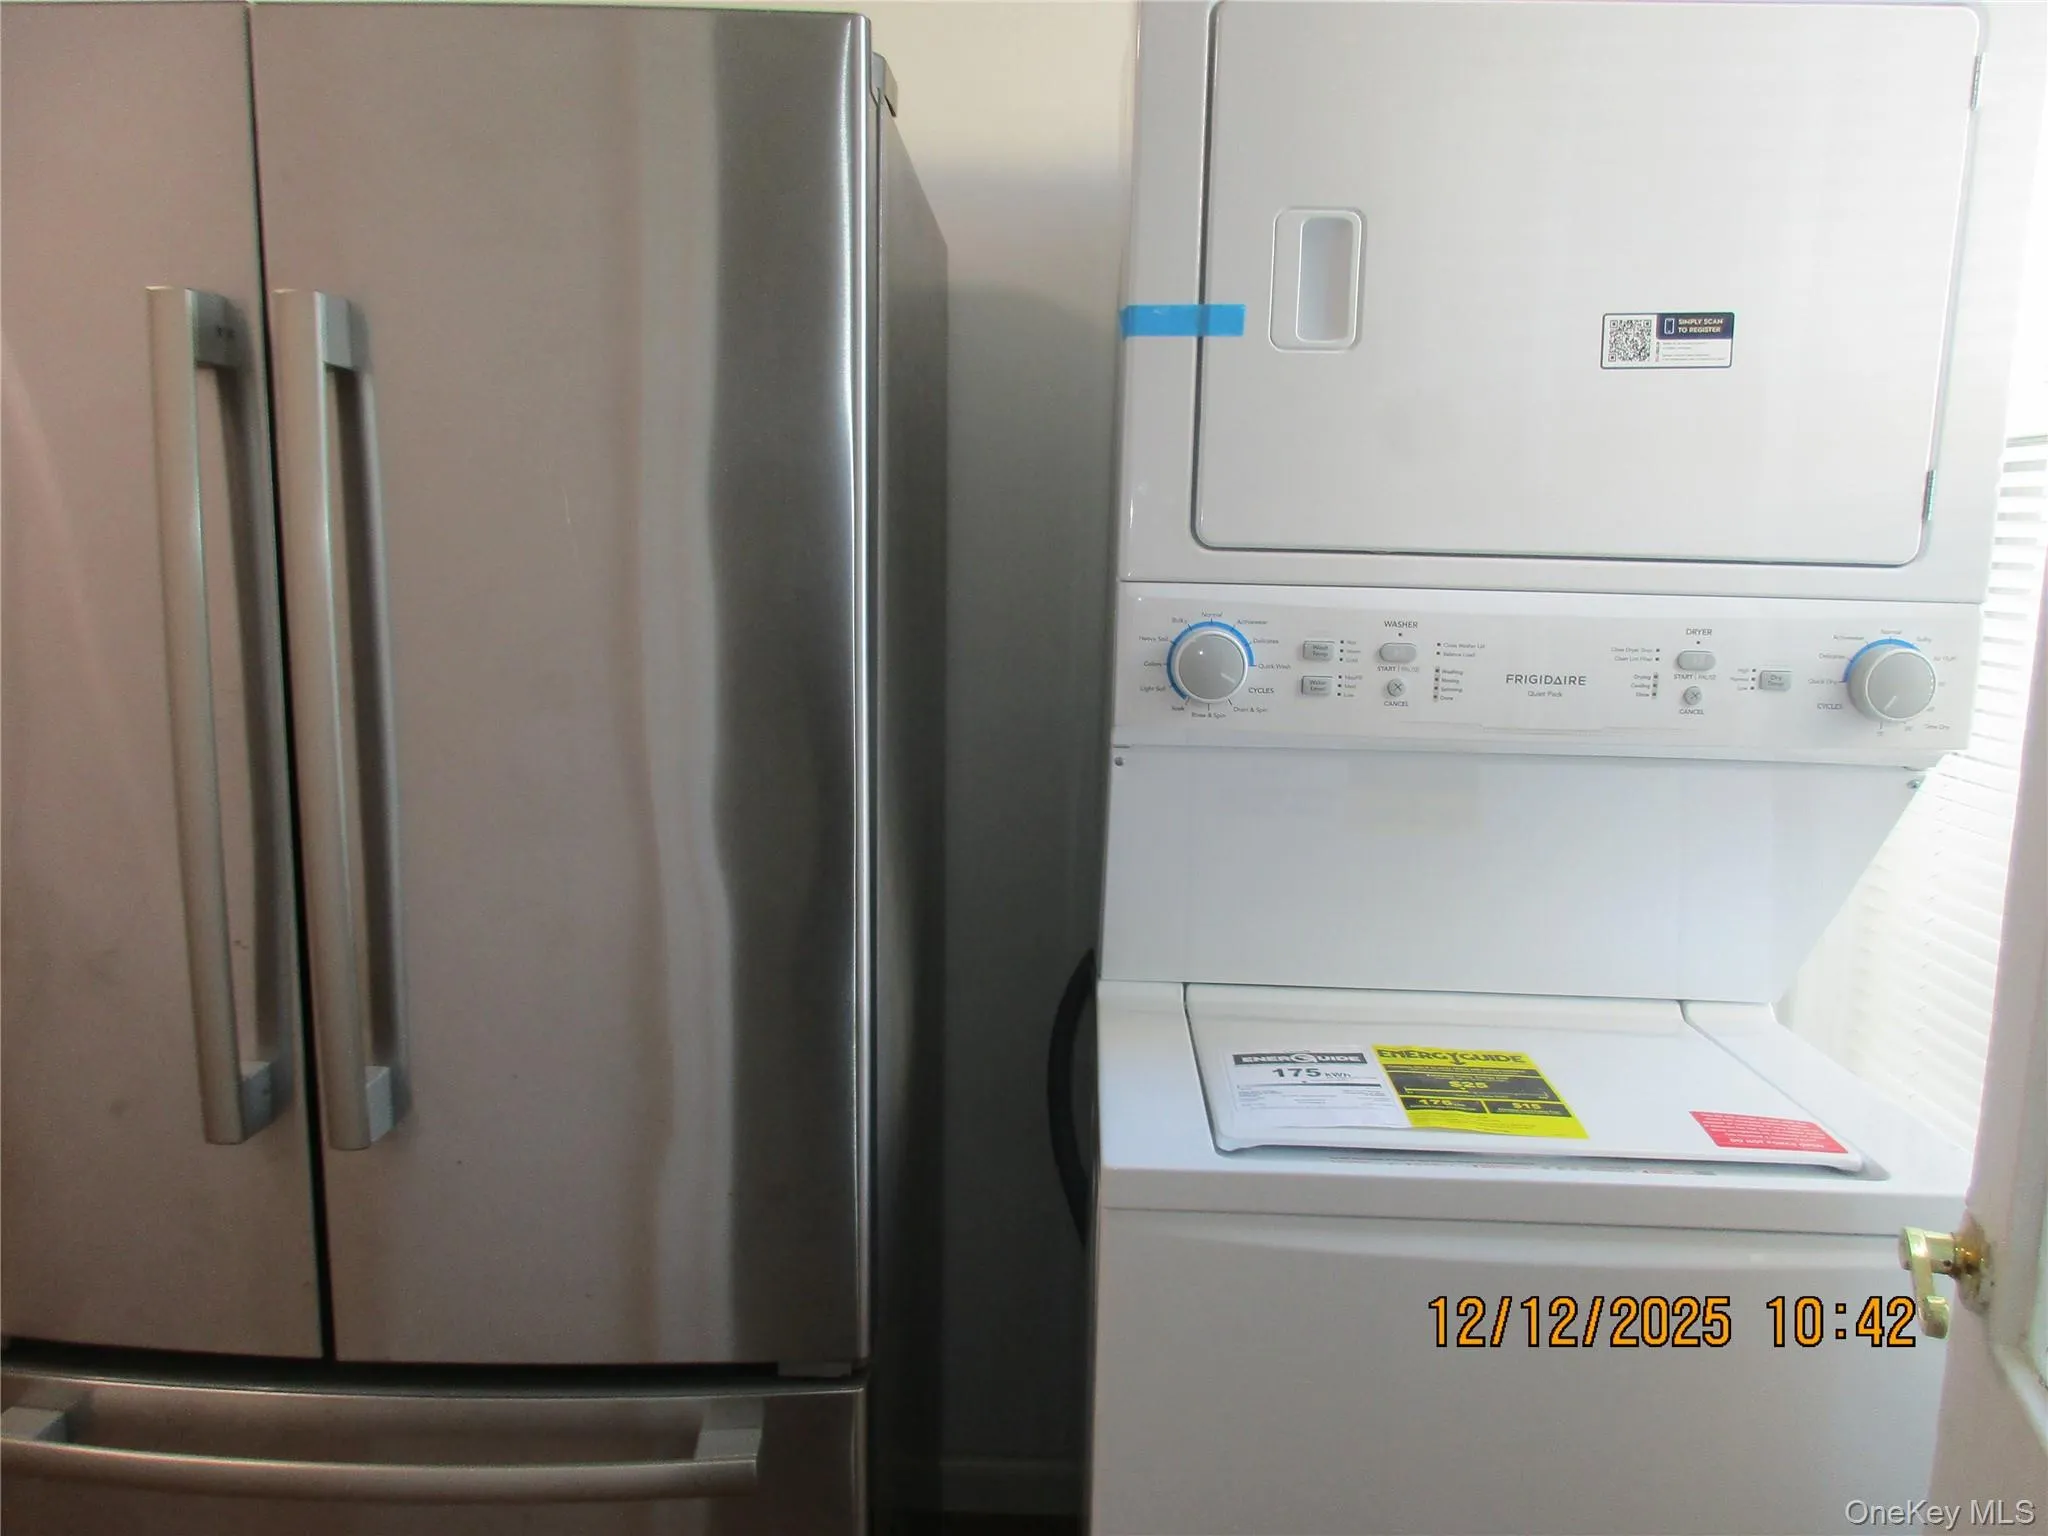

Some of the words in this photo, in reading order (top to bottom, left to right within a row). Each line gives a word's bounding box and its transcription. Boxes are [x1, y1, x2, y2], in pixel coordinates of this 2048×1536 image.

[1686, 628, 1713, 636] DRYER
[1506, 674, 1587, 686] FRIGIDAIRE
[1273, 1068, 1322, 1078] 175
